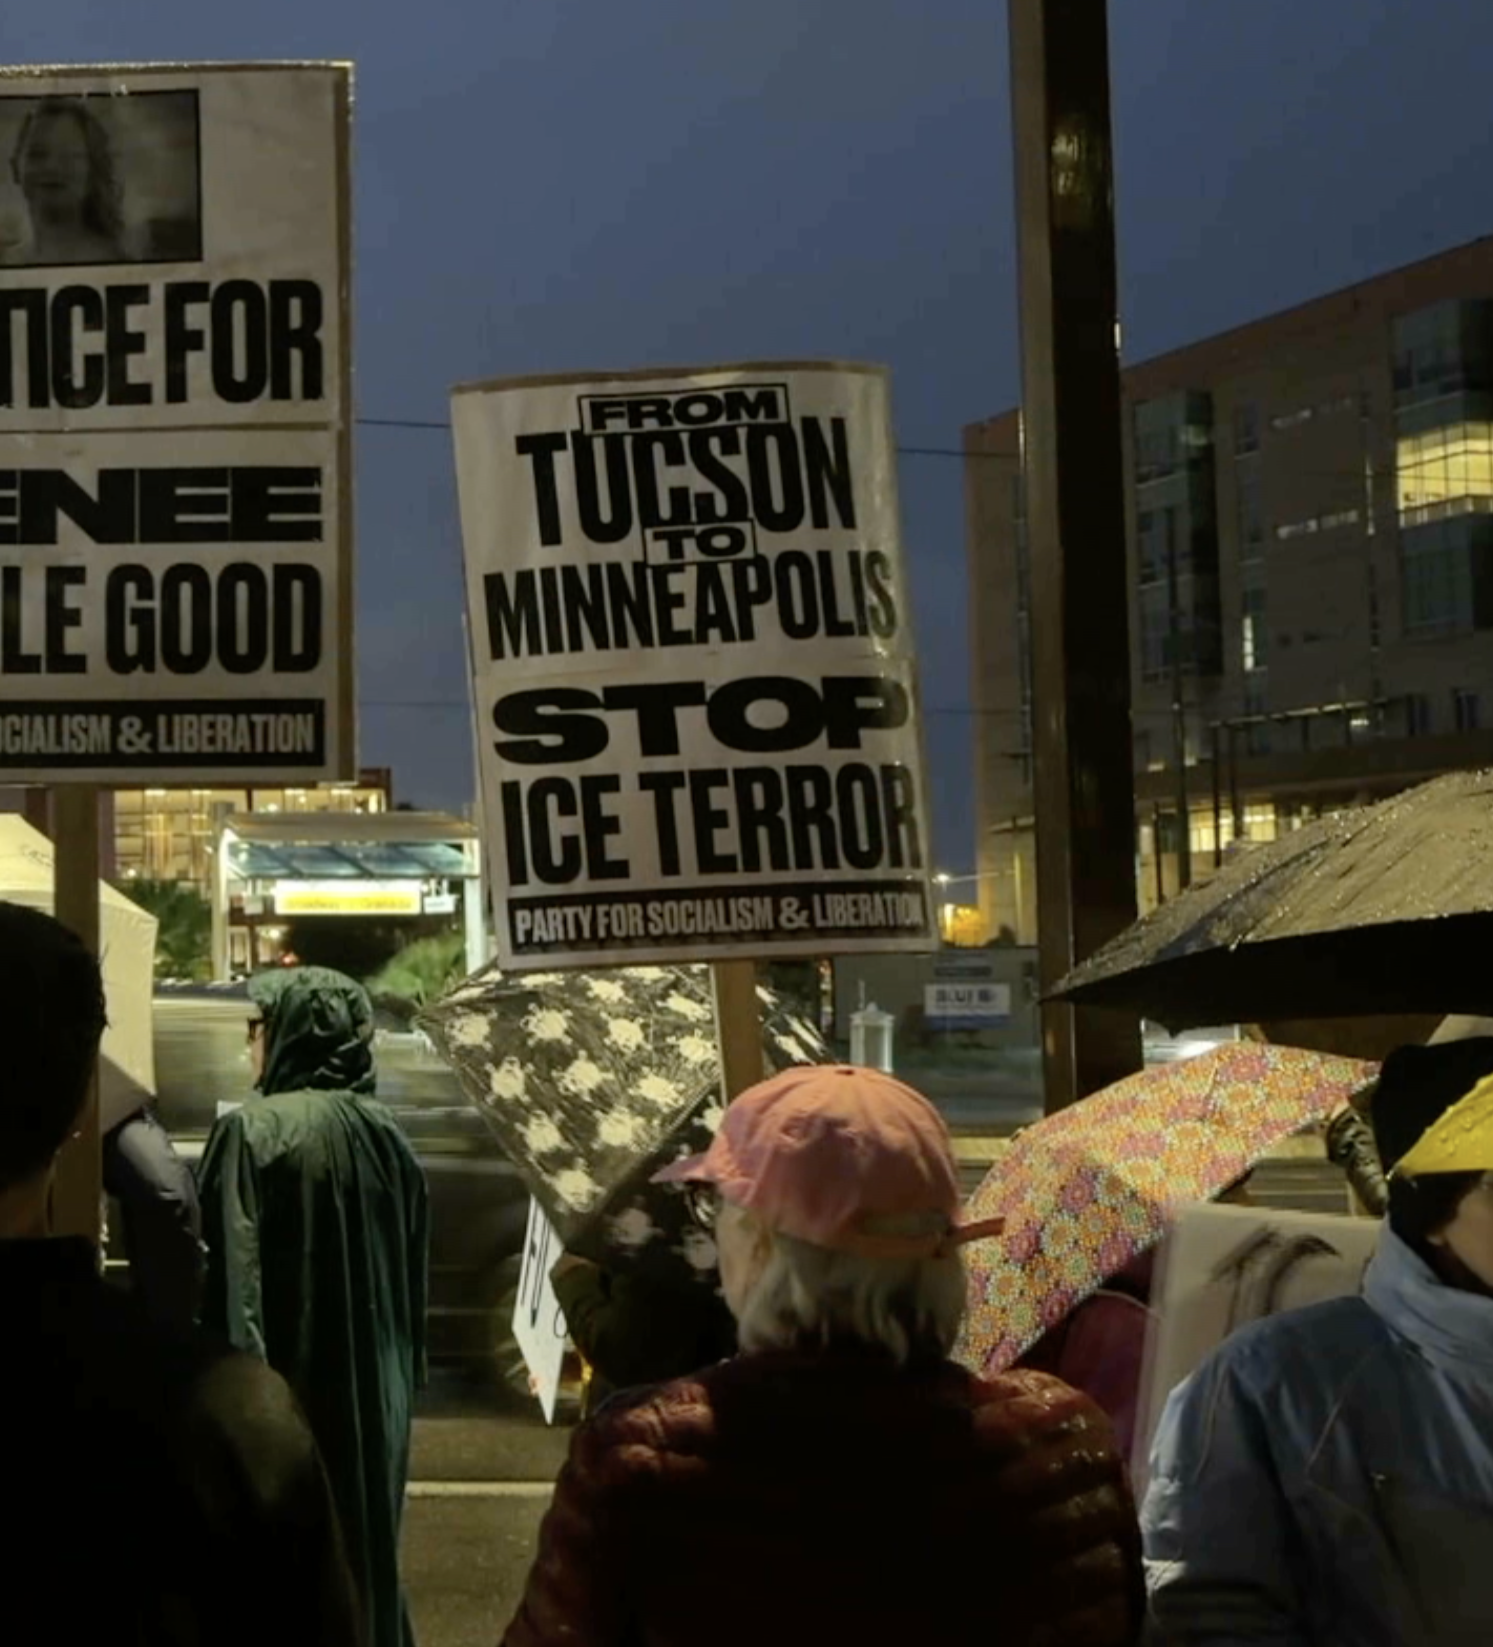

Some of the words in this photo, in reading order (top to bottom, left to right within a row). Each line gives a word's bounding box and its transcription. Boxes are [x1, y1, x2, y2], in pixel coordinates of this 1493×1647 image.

[164, 279, 324, 404] FOR
[590, 390, 781, 431] FROM
[515, 416, 857, 547] TUCSON
[653, 525, 747, 560] TO
[105, 562, 323, 675] GOOD
[483, 548, 899, 661] MINNEAPOLIS
[116, 714, 154, 755] &
[158, 711, 316, 754] LIBERATION
[492, 675, 909, 765] STOP
[500, 774, 631, 887] ICE
[638, 762, 923, 877] TERROR
[515, 903, 595, 943] PARTY
[596, 901, 645, 939] FOR
[646, 896, 775, 936] SOCIALISM
[778, 896, 811, 930] &
